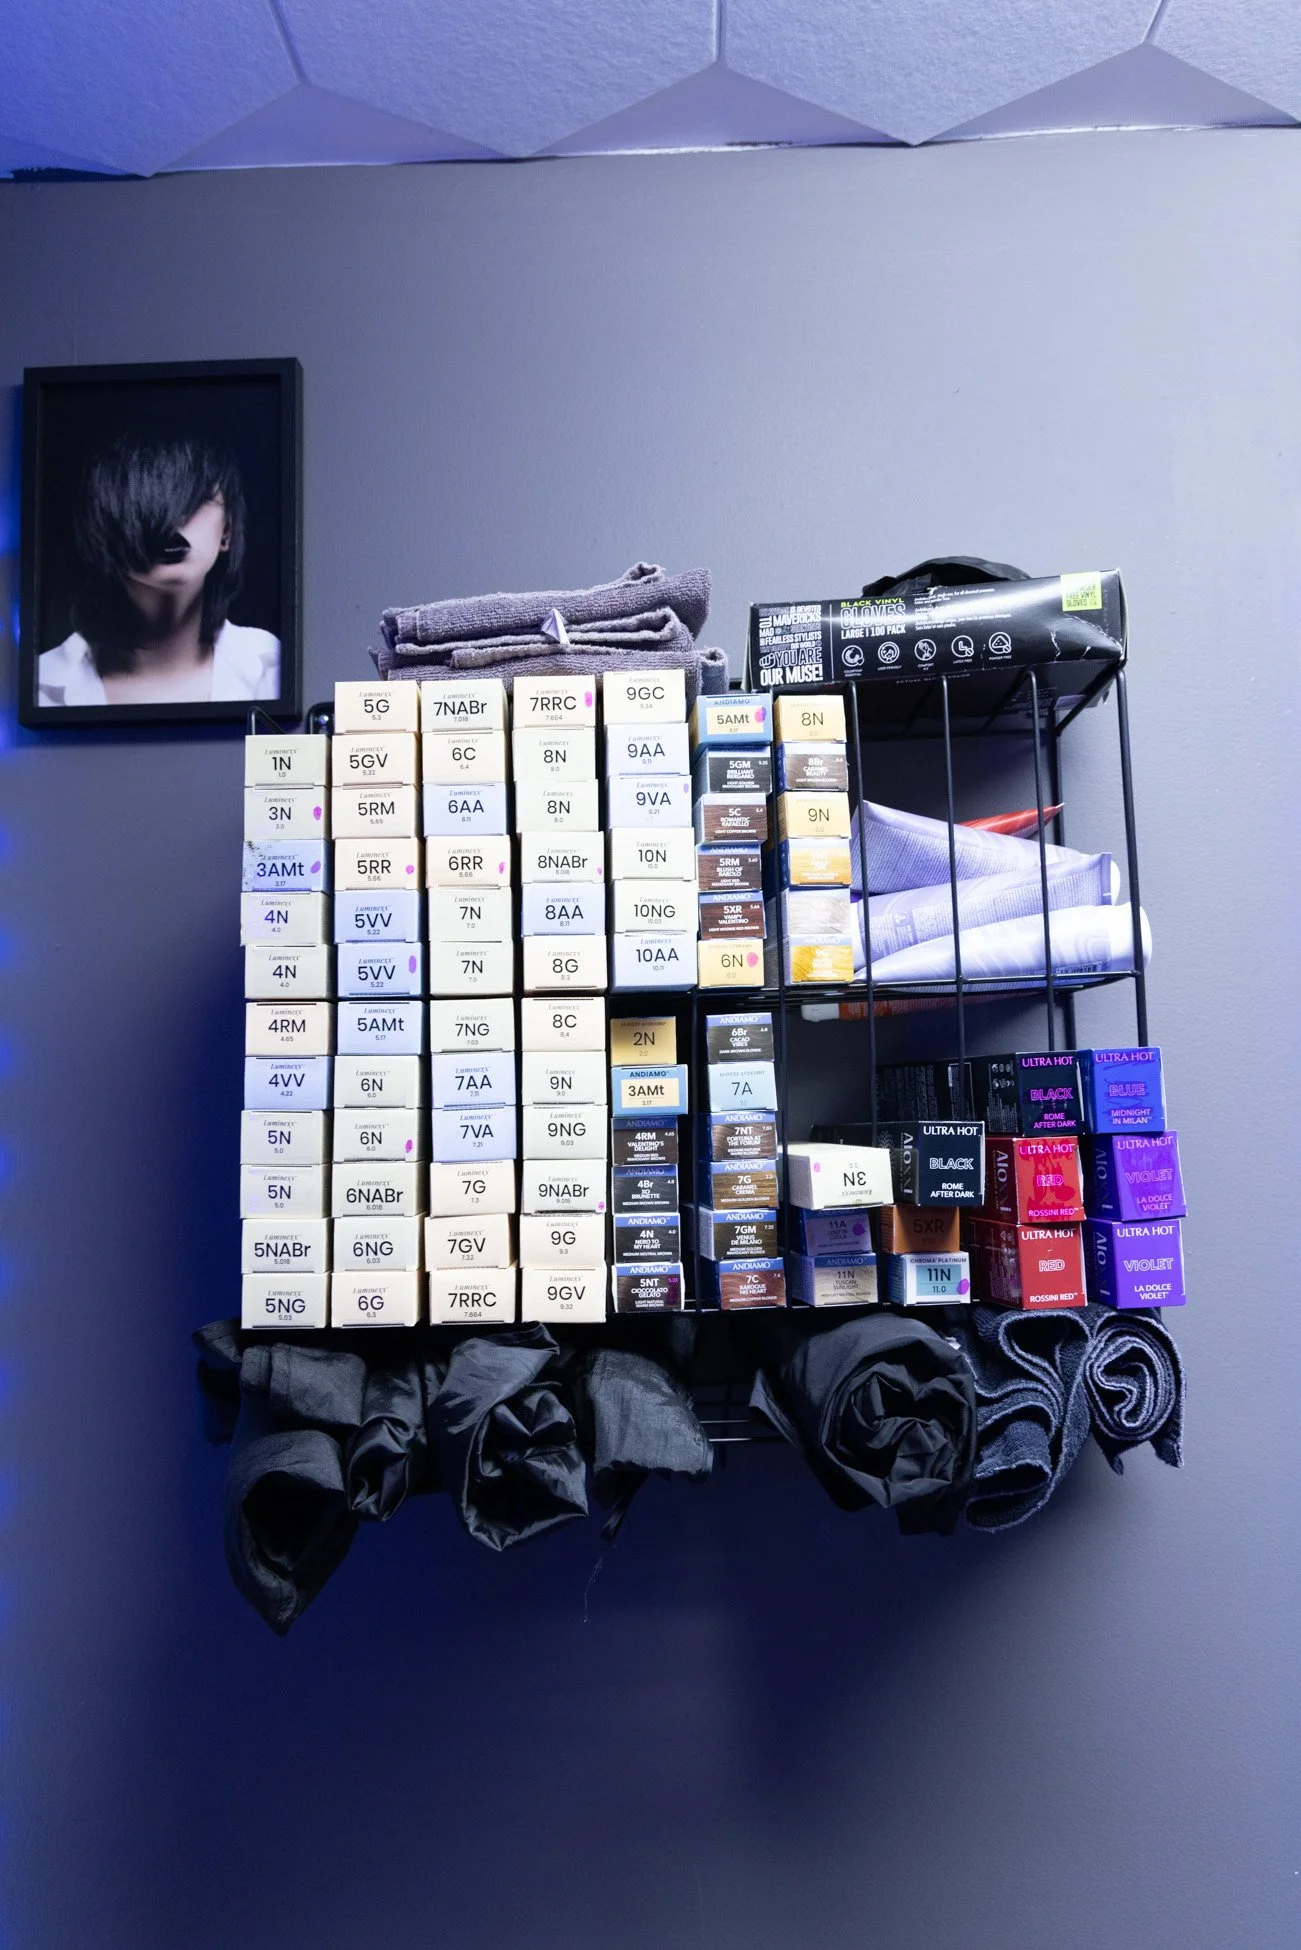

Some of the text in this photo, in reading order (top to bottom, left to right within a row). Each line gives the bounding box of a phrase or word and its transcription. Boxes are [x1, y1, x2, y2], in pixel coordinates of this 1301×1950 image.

[797, 604, 822, 613] DEVOTED
[840, 597, 904, 608] BLACK VINYL
[773, 612, 822, 627] MAVERICKS
[840, 603, 906, 630] GLOVES
[759, 628, 774, 638] MAD
[765, 634, 794, 645] FEARLESS
[794, 631, 822, 641] STYLISTS
[841, 628, 864, 640] LARGE
[870, 626, 885, 637] 100
[887, 623, 906, 636] PACK
[775, 647, 822, 667] YOU ARE
[760, 667, 784, 686] OUR
[785, 664, 823, 684] MUSE!
[626, 686, 665, 701] 9GC
[363, 699, 390, 713] 5G
[433, 700, 487, 716] 7NABr
[529, 696, 577, 711] 7RRC
[716, 713, 750, 725] 5AMt
[801, 713, 824, 726] 8N
[452, 747, 476, 761] 6C
[543, 750, 567, 764] 8N
[627, 743, 665, 758] 9AA
[272, 757, 291, 771] 1N
[349, 754, 388, 769] 5GV
[729, 760, 751, 769] 5GM
[635, 792, 671, 806] 9VA
[268, 807, 292, 821] 3N
[357, 802, 395, 816] 5RM
[448, 800, 484, 814] 6AA
[728, 808, 741, 817] 5C
[808, 809, 830, 822] 9N
[537, 855, 588, 869] 8NABr
[638, 849, 667, 863] 10N
[719, 857, 740, 866] 5RM
[256, 862, 304, 877] 3AMt
[357, 859, 391, 874] 5RR
[448, 856, 483, 871] 6RR
[459, 906, 482, 920] 7N
[545, 905, 584, 920] 8AA
[633, 904, 675, 918] 10NG
[723, 905, 742, 914] 5XR
[264, 910, 288, 924] 4N
[354, 913, 392, 928] 5VV
[635, 948, 679, 963] 10AA
[721, 955, 743, 968] 6N
[552, 958, 579, 974] 8G
[268, 1019, 306, 1034] 4RM
[357, 1016, 404, 1032] 5AMt
[552, 1014, 577, 1029] 8C
[455, 1023, 490, 1037] 7NG
[731, 1028, 747, 1037] 6Br
[633, 1032, 655, 1046] 2N
[1022, 1056, 1073, 1068] ULTRA HOT
[1095, 1051, 1154, 1063] ULTRA HOT
[268, 1073, 305, 1088] 4VV
[360, 1078, 383, 1092] 6N
[454, 1075, 492, 1091] 7AA
[550, 1076, 573, 1090] 9N
[628, 1085, 665, 1097] 3AMt
[731, 1082, 752, 1095] 7A
[1030, 1088, 1073, 1101] BLACK
[1109, 1084, 1145, 1097] BLUE
[1111, 1109, 1151, 1117] MIDNIGHT
[1033, 1120, 1058, 1128] AFTER
[1112, 1117, 1120, 1125] IN
[460, 1125, 494, 1139] 7VA
[547, 1122, 586, 1137] 9NG
[635, 1132, 656, 1140] 4RM
[734, 1126, 754, 1135] 7NT
[923, 1126, 978, 1135] ULTRA HOT
[267, 1130, 291, 1145] 5N
[1117, 1137, 1173, 1151] ULTRA HOT
[1019, 1143, 1074, 1155] ULTRA HOT
[929, 1158, 974, 1170] BLACK
[737, 1176, 752, 1185] 7G
[844, 1171, 866, 1187] 3N
[1037, 1174, 1064, 1187] RED
[1125, 1169, 1173, 1183] VIOLET
[462, 1180, 486, 1195] 7G
[538, 1183, 589, 1198] 9NABr
[637, 1180, 654, 1189] 4Br
[345, 1188, 403, 1204] 6NABr
[954, 1190, 975, 1198] DARK
[1145, 1194, 1173, 1203] DOLCE
[726, 1212, 764, 1221] ANDIAMO
[1028, 1209, 1058, 1217] ROSSINI
[628, 1216, 667, 1225] ANDIAMO
[913, 1219, 944, 1233] 5XR
[640, 1230, 654, 1238] 4N
[734, 1225, 757, 1235] 7GM
[1021, 1228, 1075, 1240] ULTRA HOT
[1117, 1226, 1174, 1238] ULTRA HOT
[550, 1230, 576, 1245] 9G
[254, 1243, 311, 1258] 5NABr
[352, 1240, 394, 1257] 6NG
[447, 1238, 486, 1254] 7GV
[826, 1258, 864, 1266] ANDIAMO
[1038, 1259, 1065, 1272] RED
[1123, 1258, 1173, 1272] VIOLET
[630, 1266, 669, 1274] ANDIAMO
[836, 1271, 855, 1279] 11N
[927, 1269, 951, 1281] 11N
[640, 1278, 659, 1287] 5NT
[746, 1275, 759, 1284] 7C
[547, 1285, 586, 1301] 9GV
[932, 1285, 946, 1293] 11.0
[1134, 1283, 1172, 1293] LA DOLCE
[358, 1295, 384, 1311] 6G
[448, 1292, 497, 1308] 7RRC
[1030, 1293, 1059, 1302] ROSSINI
[265, 1298, 306, 1314] 5NG
